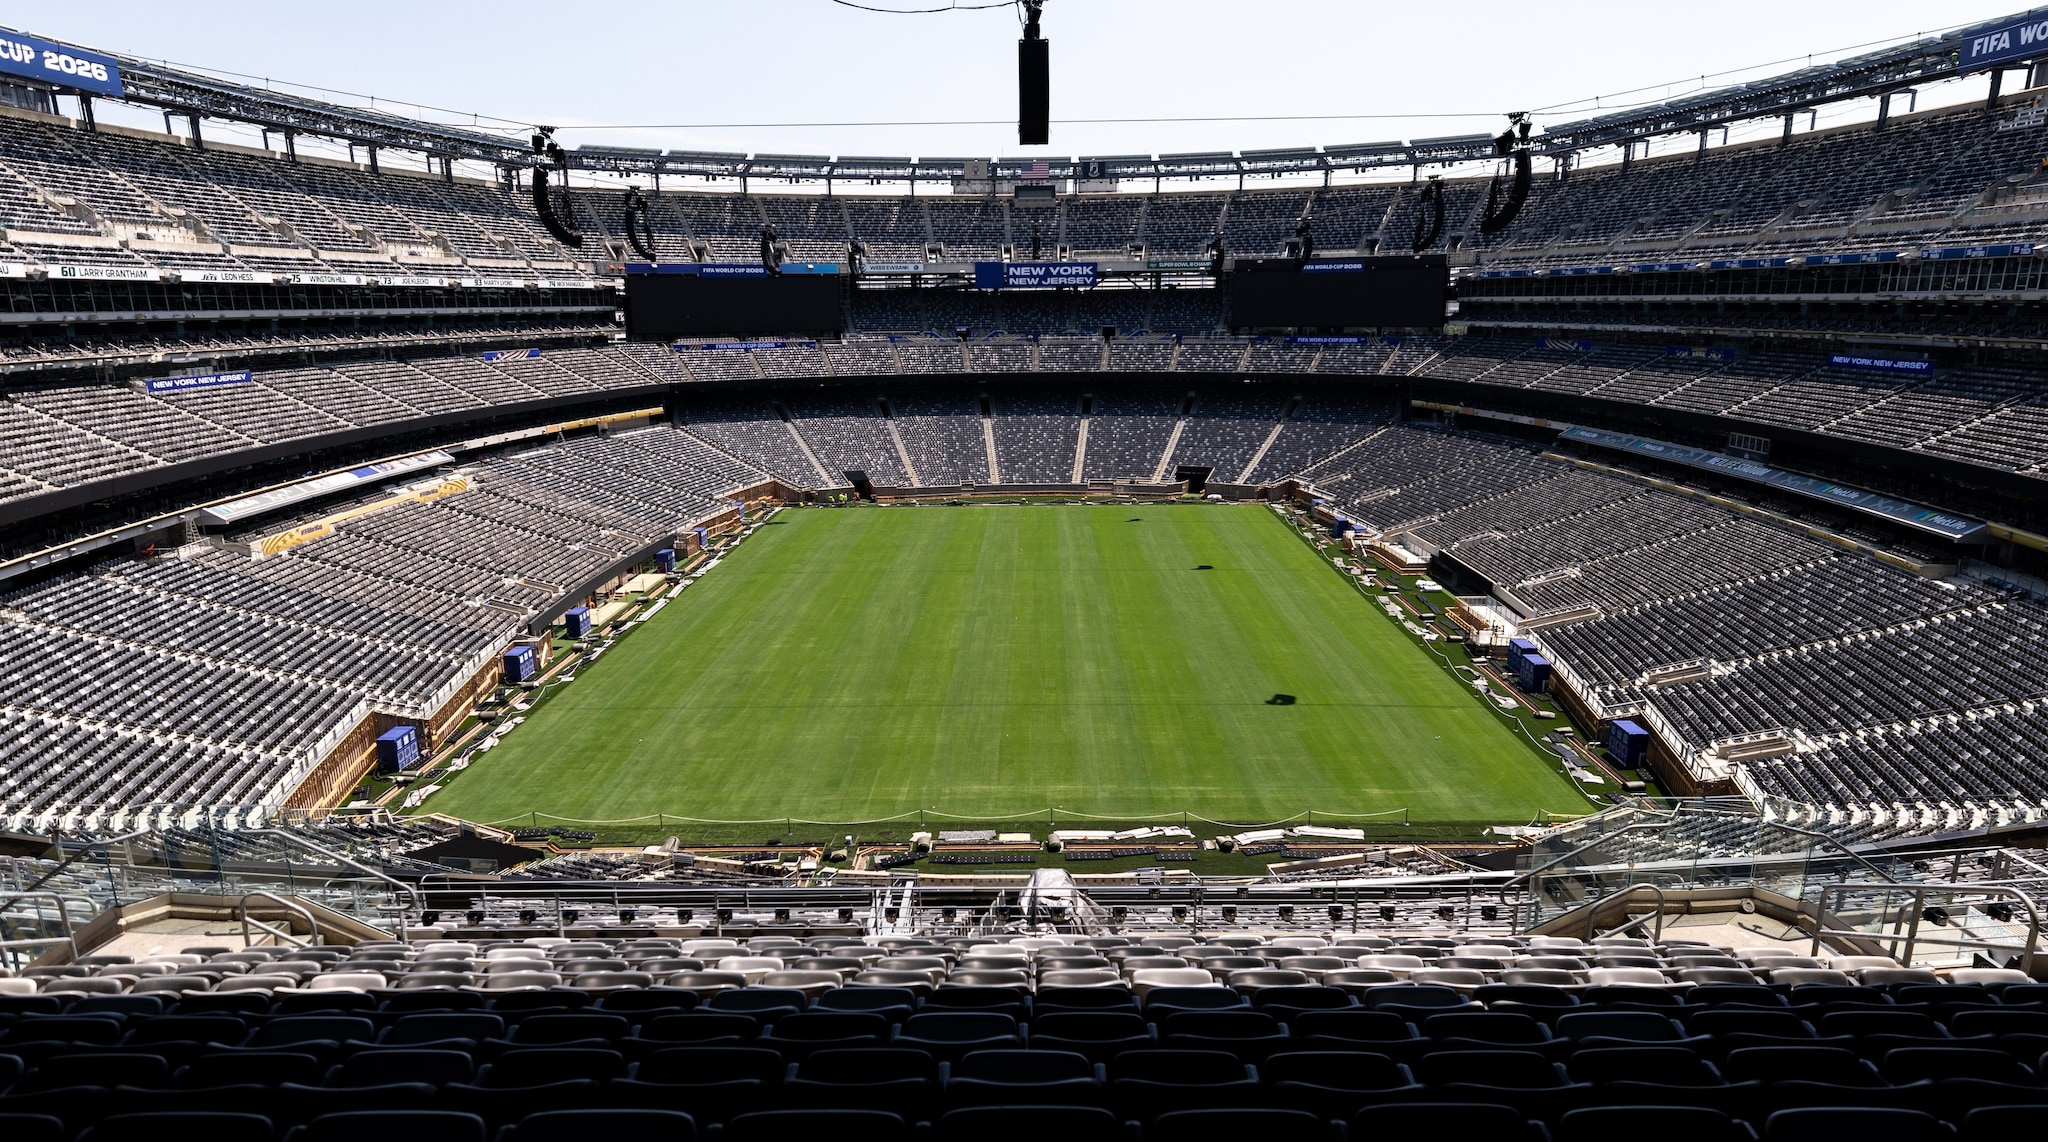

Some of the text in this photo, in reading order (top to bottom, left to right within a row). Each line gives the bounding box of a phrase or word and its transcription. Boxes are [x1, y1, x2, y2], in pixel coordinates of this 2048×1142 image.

[1971, 31, 2011, 57] FIFA
[0, 38, 108, 81] CUP 2026
[61, 266, 148, 278] 60 LARRY GRANTHAM
[221, 273, 237, 281] LEON
[238, 273, 253, 281] HESS
[1009, 266, 1094, 276] NEW YORK
[291, 274, 301, 283] 75
[309, 275, 335, 283] WINSTON
[383, 277, 392, 285] 73
[1009, 277, 1094, 285] NEW JERSEY
[1851, 357, 1873, 365] YORK
[1893, 361, 1928, 369] JERSEY
[153, 373, 246, 389] NEW YORK NEW JERSEY
[1830, 487, 1859, 499] MetLife
[1929, 516, 1966, 530] MetLife
